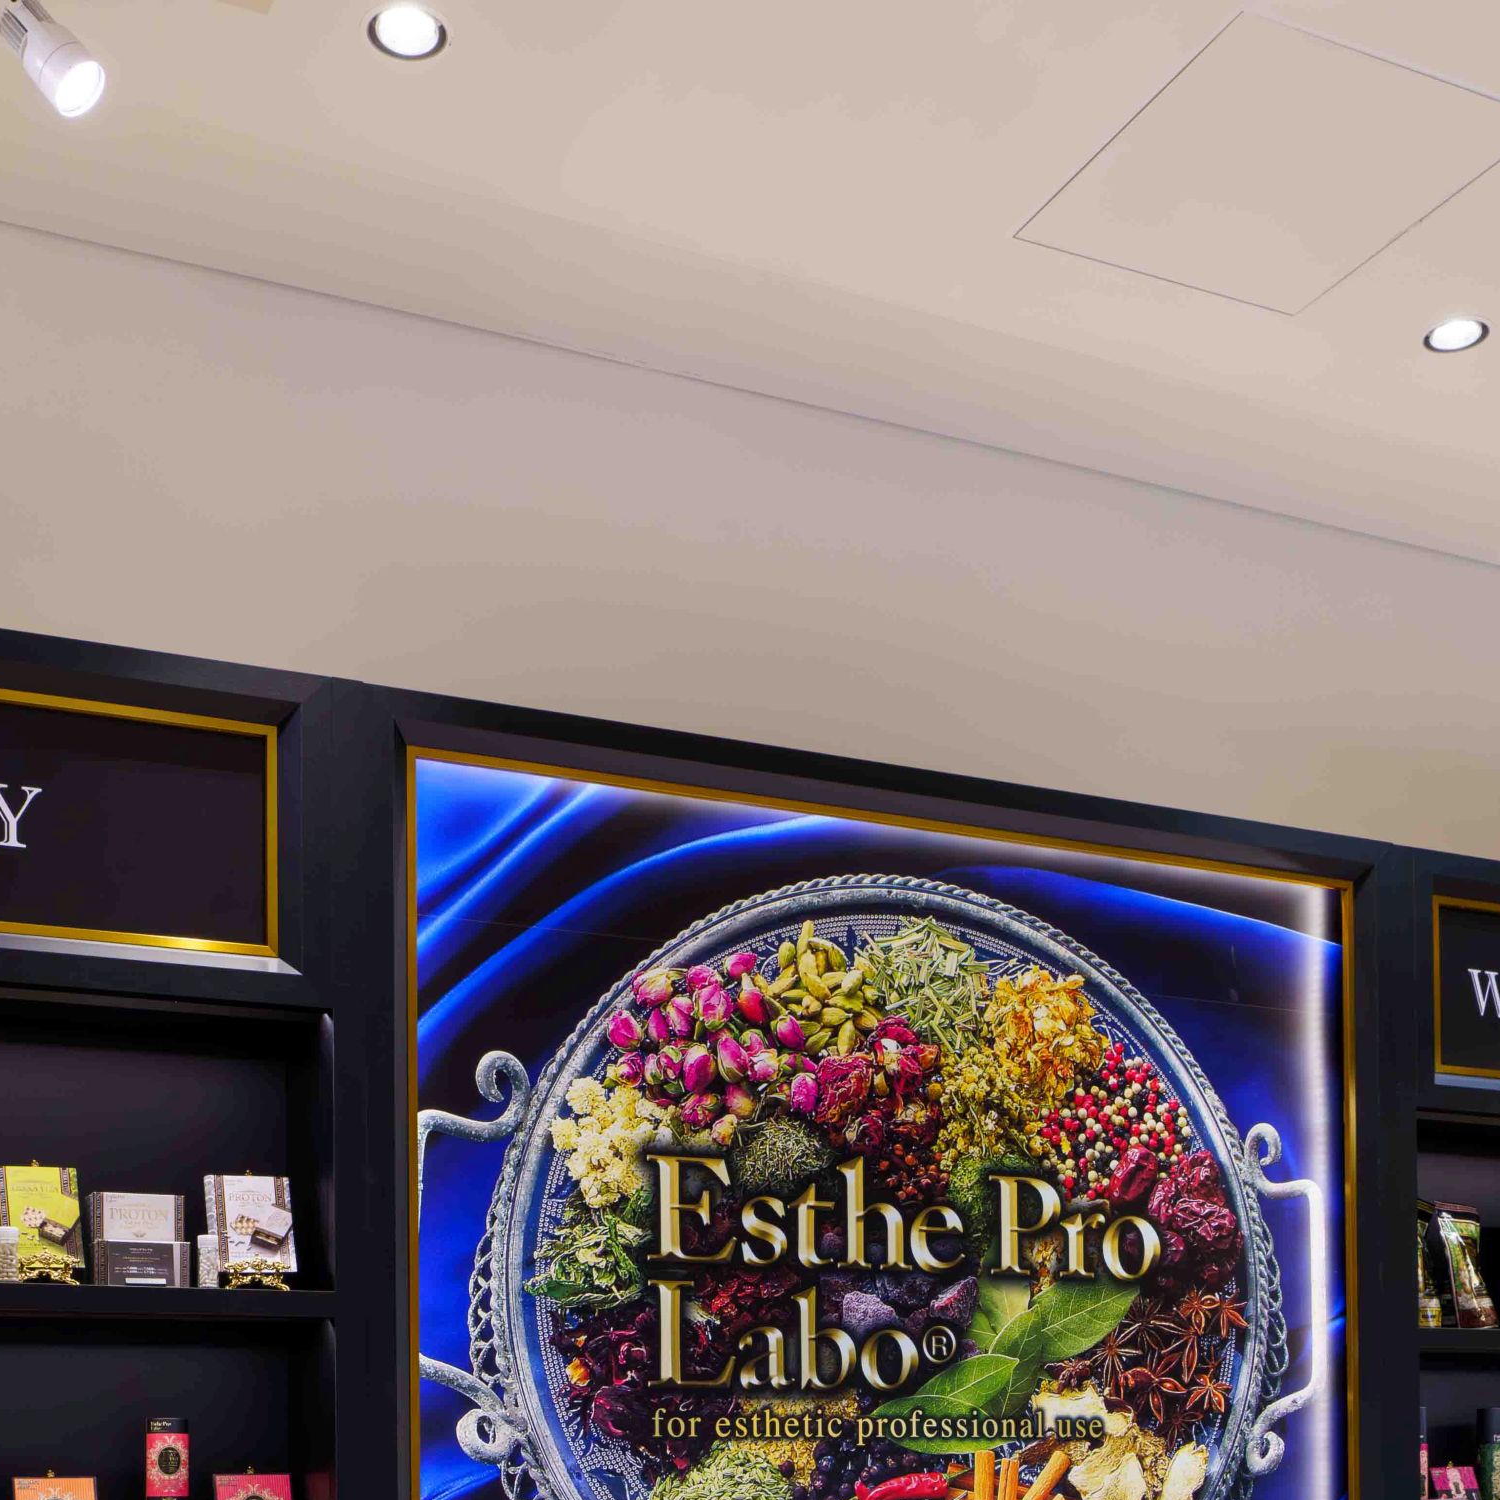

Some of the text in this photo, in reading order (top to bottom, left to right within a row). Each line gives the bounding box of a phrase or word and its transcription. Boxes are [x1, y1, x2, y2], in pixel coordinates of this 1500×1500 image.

[228, 1193, 272, 1202] PROTON
[109, 1207, 169, 1221] PROTON
[646, 1154, 1162, 1281] Esthe Pro
[652, 1407, 1104, 1446] for esthetic professional use
